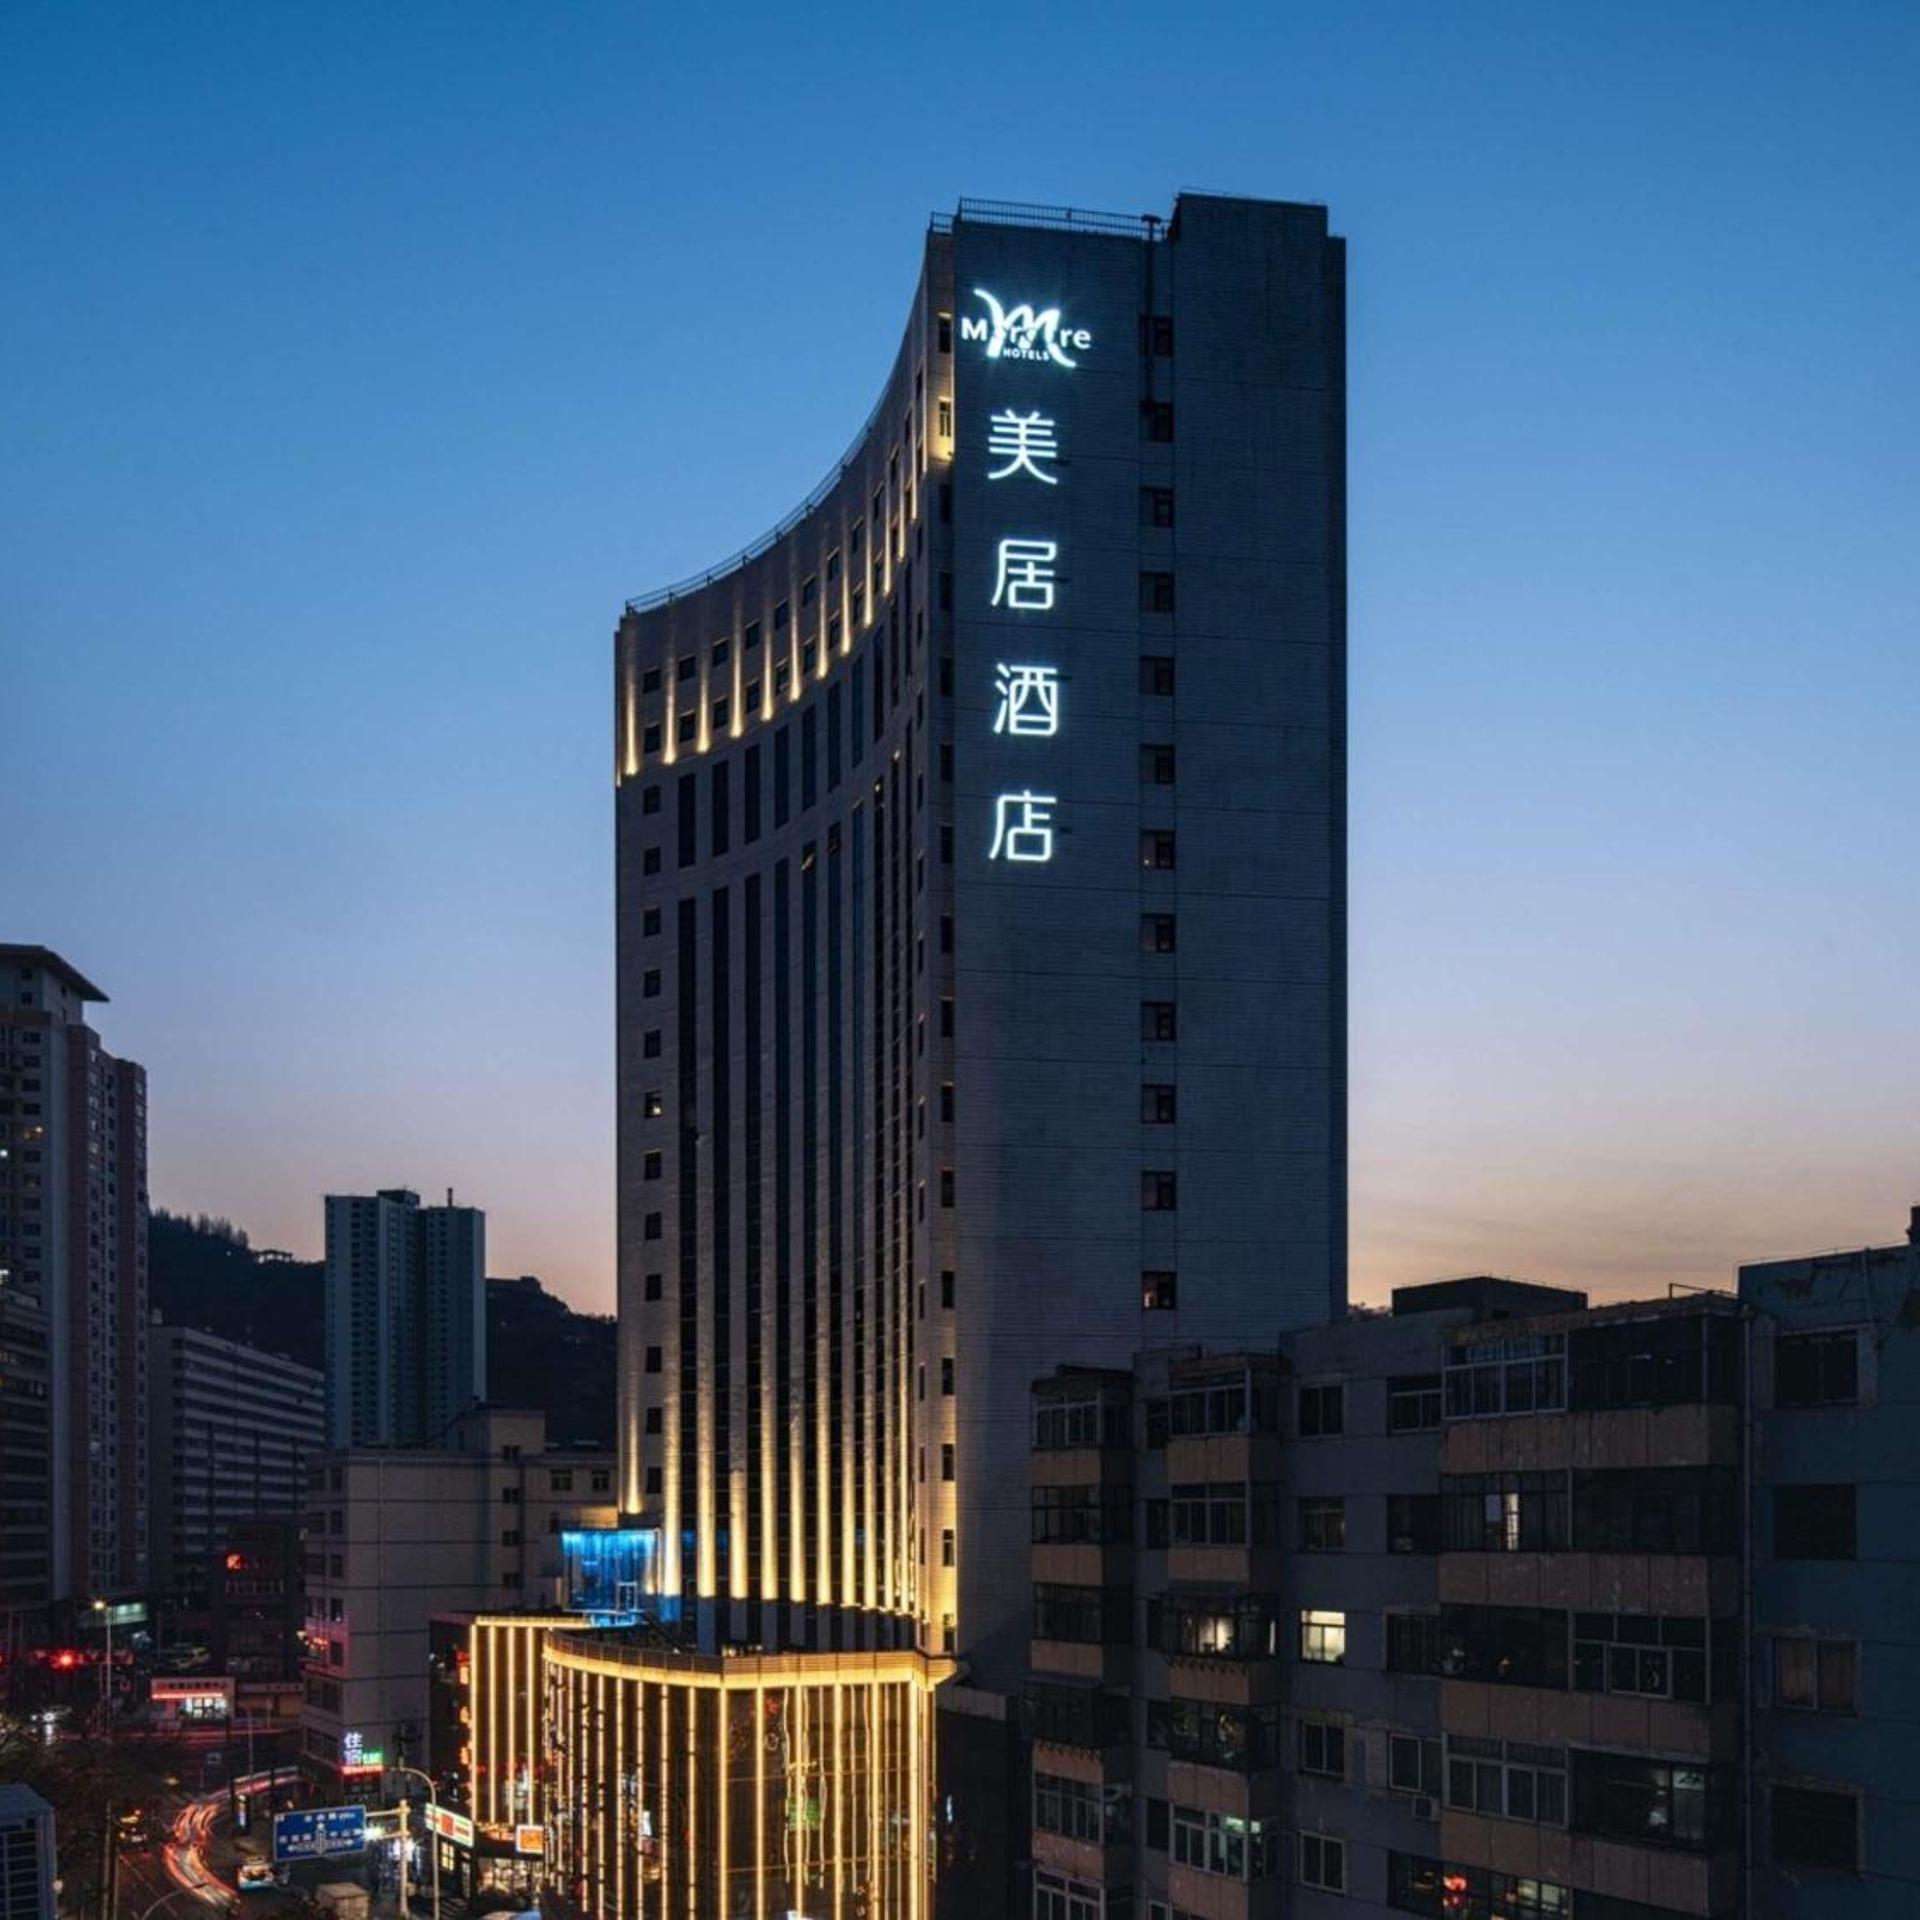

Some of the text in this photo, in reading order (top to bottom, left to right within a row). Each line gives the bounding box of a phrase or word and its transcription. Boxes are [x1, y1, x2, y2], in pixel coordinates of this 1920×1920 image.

[1003, 347, 1050, 361] HOTELS
[988, 409, 1058, 862] 美居酒店
